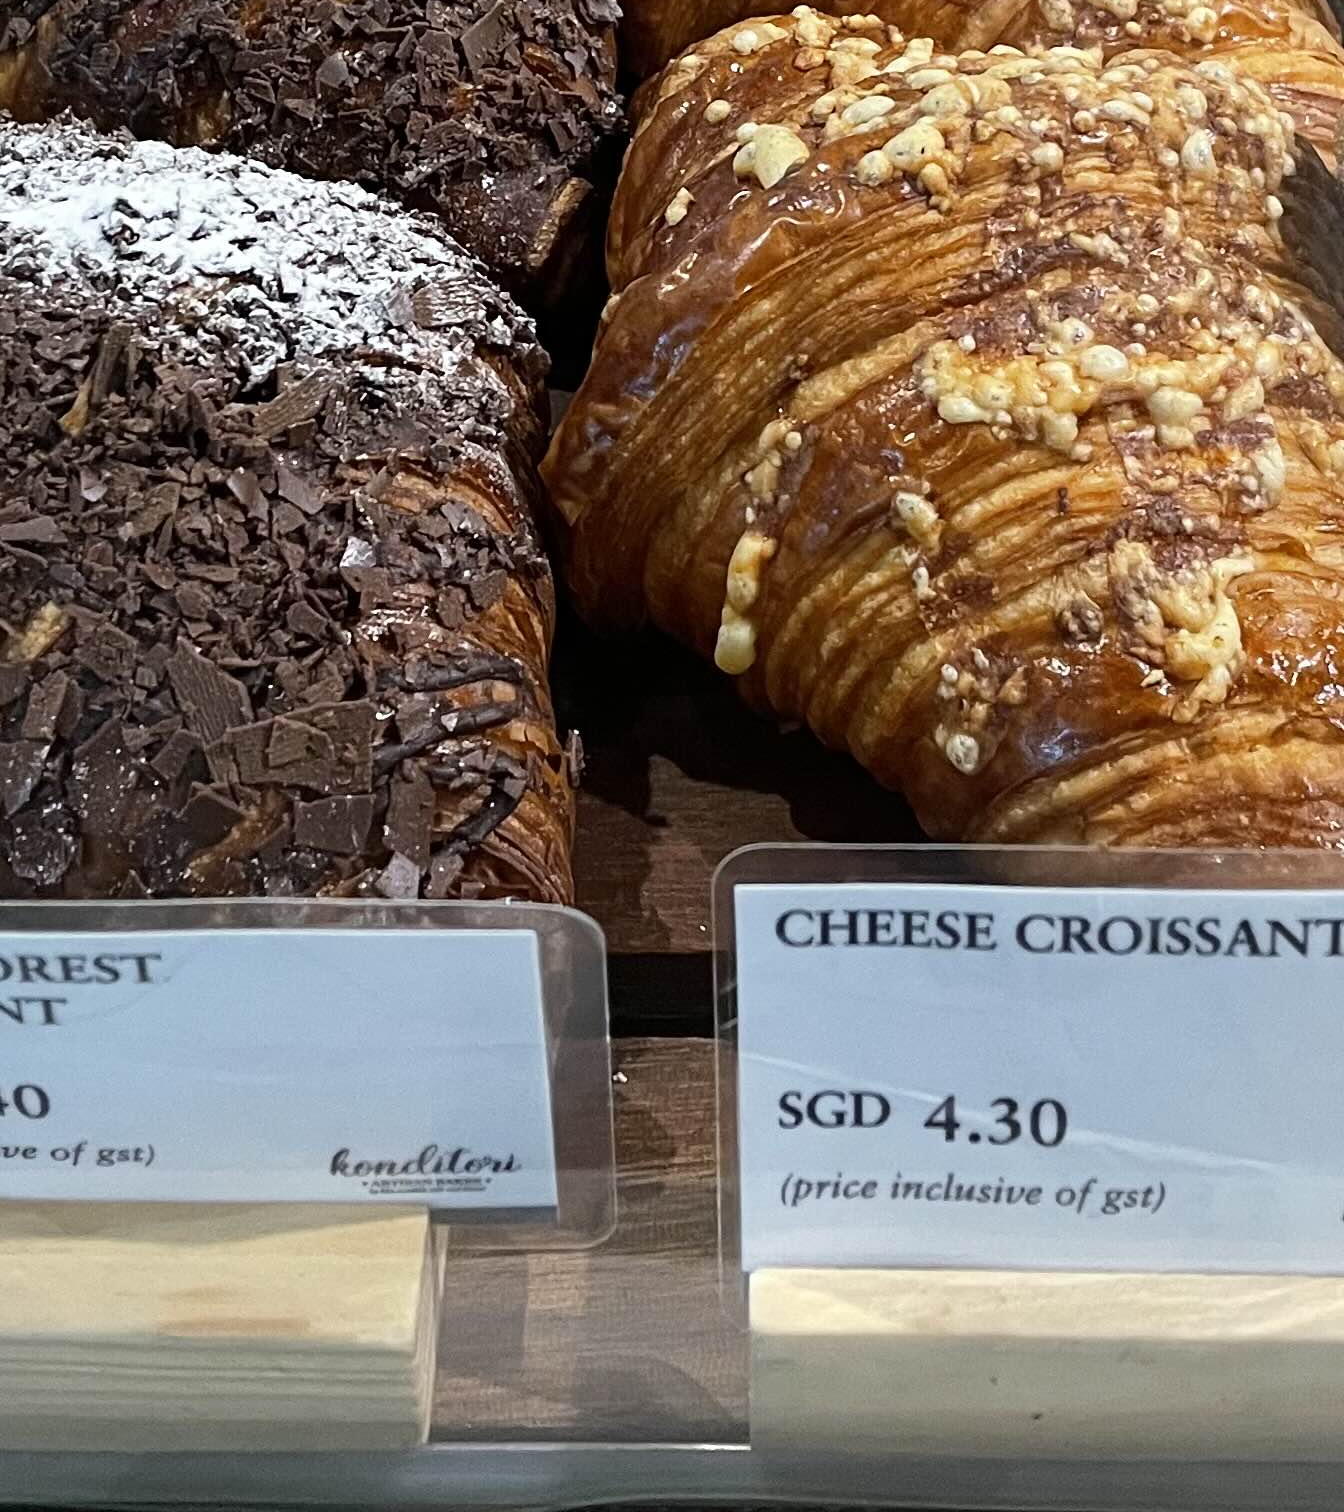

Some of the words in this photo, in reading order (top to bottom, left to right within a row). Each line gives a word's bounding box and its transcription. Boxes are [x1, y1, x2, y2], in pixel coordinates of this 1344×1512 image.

[774, 909, 998, 952] CHEESE
[777, 1090, 892, 1130] SGD
[923, 1097, 1069, 1148] 4.30
[49, 1138, 89, 1165] of
[96, 1142, 155, 1168] gst)
[329, 1144, 522, 1177] konditori
[779, 1172, 878, 1207] (price
[889, 1172, 1043, 1207] inclusive
[1054, 1178, 1097, 1214] of
[1102, 1182, 1168, 1215] gst)
